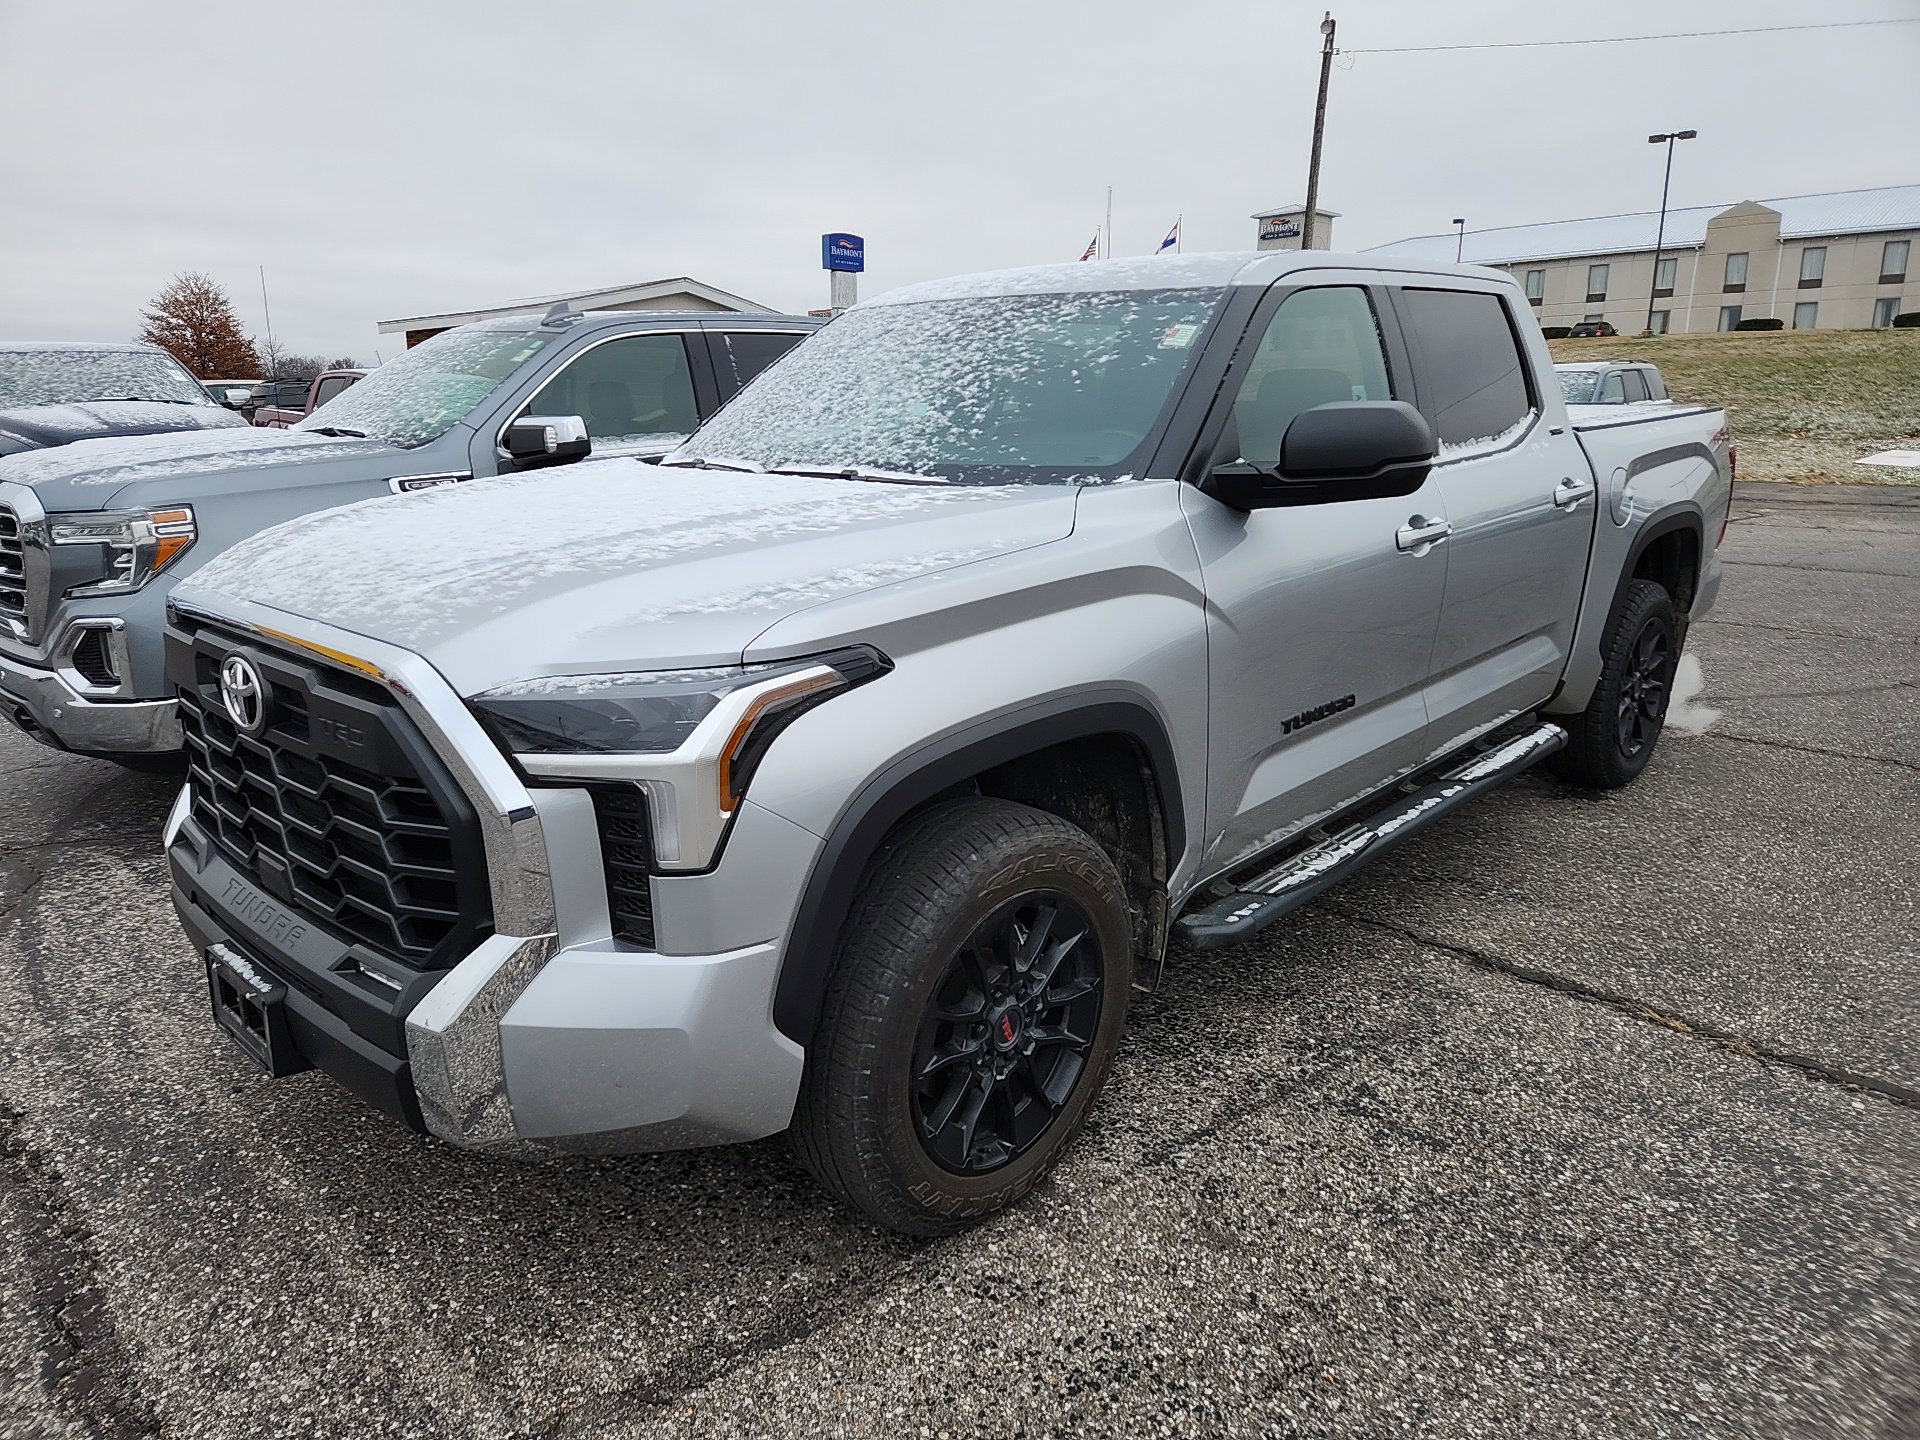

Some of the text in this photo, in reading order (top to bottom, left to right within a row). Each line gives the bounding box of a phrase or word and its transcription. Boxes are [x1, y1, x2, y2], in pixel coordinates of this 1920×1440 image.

[1260, 222, 1300, 235] BAYMONT
[830, 245, 863, 258] BAYMONT
[220, 877, 307, 950] TUNDRA
